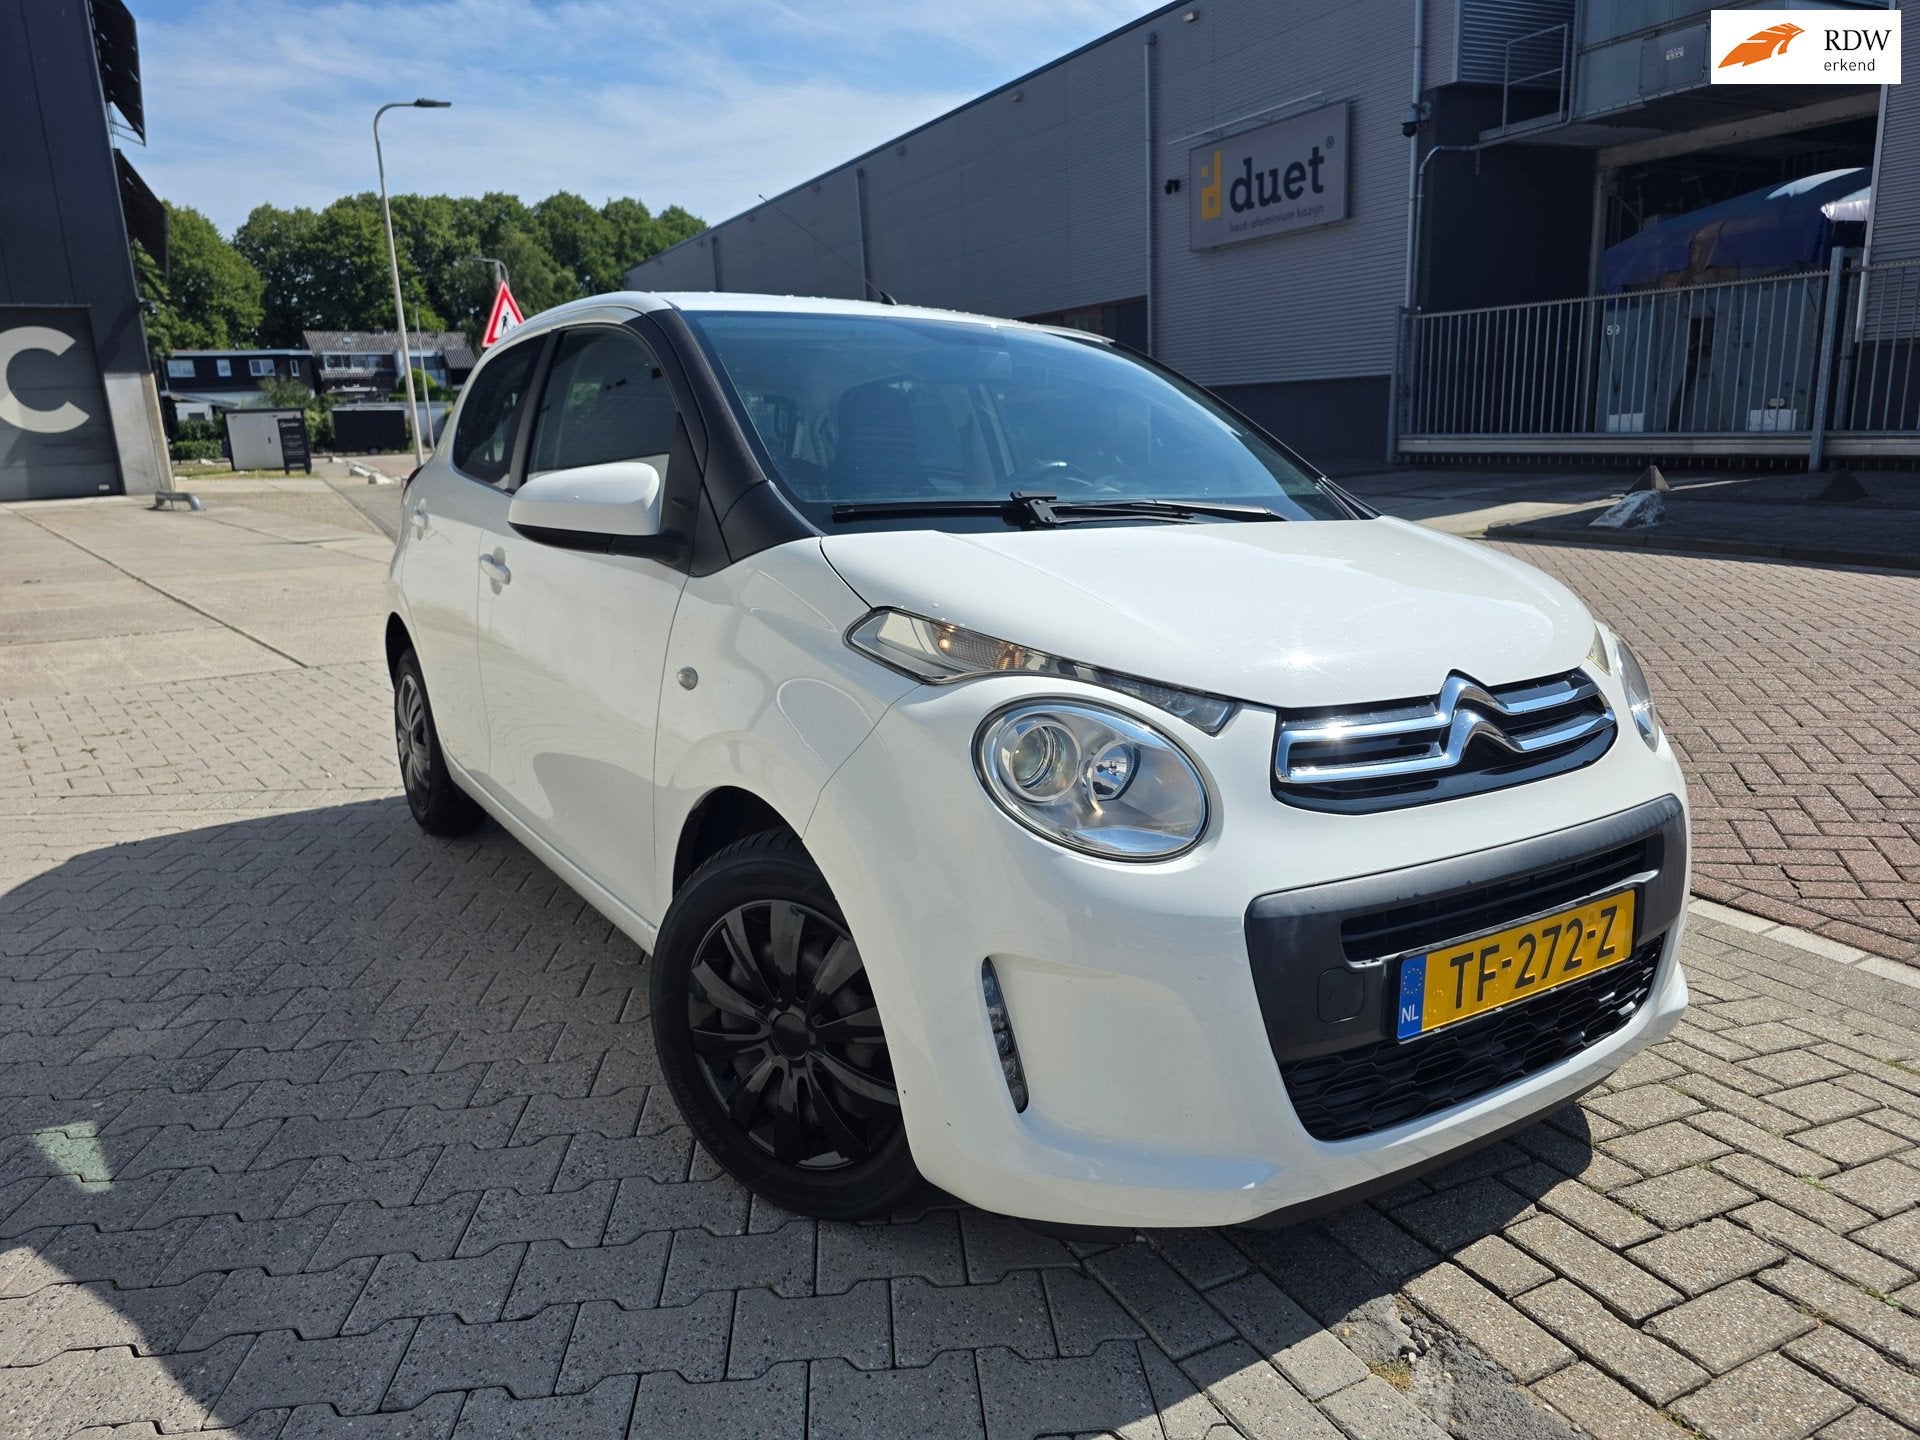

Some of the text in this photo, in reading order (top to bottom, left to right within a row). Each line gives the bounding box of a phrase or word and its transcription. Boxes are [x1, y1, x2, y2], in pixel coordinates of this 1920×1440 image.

[1229, 146, 1325, 213] duet
[0, 326, 90, 433] C
[1450, 905, 1618, 1010] TF-272-Z
[1401, 1003, 1420, 1024] NL
